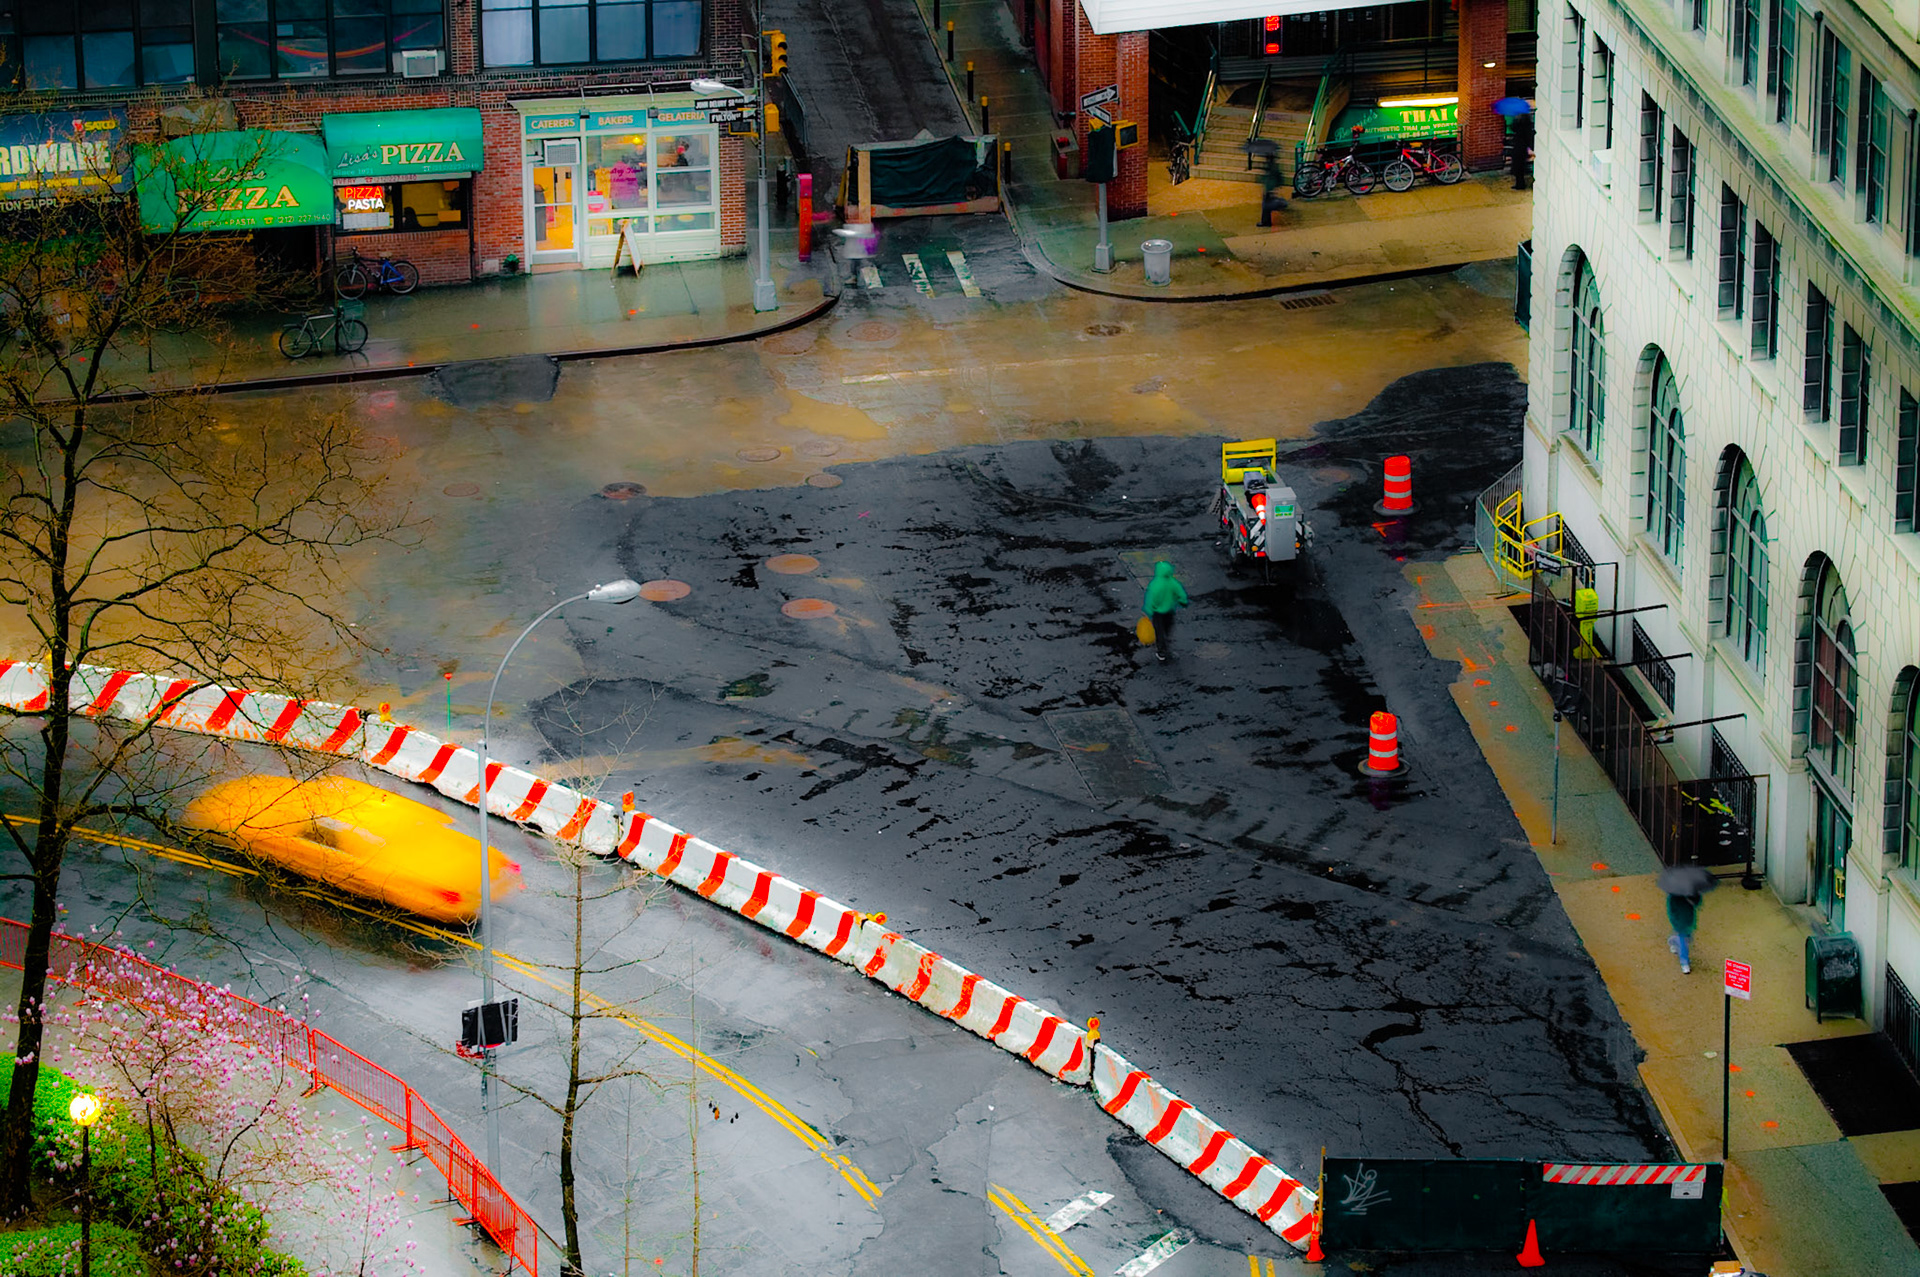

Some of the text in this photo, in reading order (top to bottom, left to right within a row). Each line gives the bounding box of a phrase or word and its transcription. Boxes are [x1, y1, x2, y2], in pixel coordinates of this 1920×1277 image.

[598, 115, 633, 126] BAKERS
[657, 111, 705, 122] GELATERIA
[711, 112, 736, 122] FULTON
[1400, 108, 1448, 123] THAI
[84, 120, 116, 131] SATCO
[531, 119, 575, 129] CATERERS
[337, 142, 465, 168] Lisa's PIZZA
[345, 187, 383, 199] PIZZA
[175, 186, 299, 213] PIZZA
[348, 199, 385, 210] PASTA
[230, 218, 255, 226] PASTA
